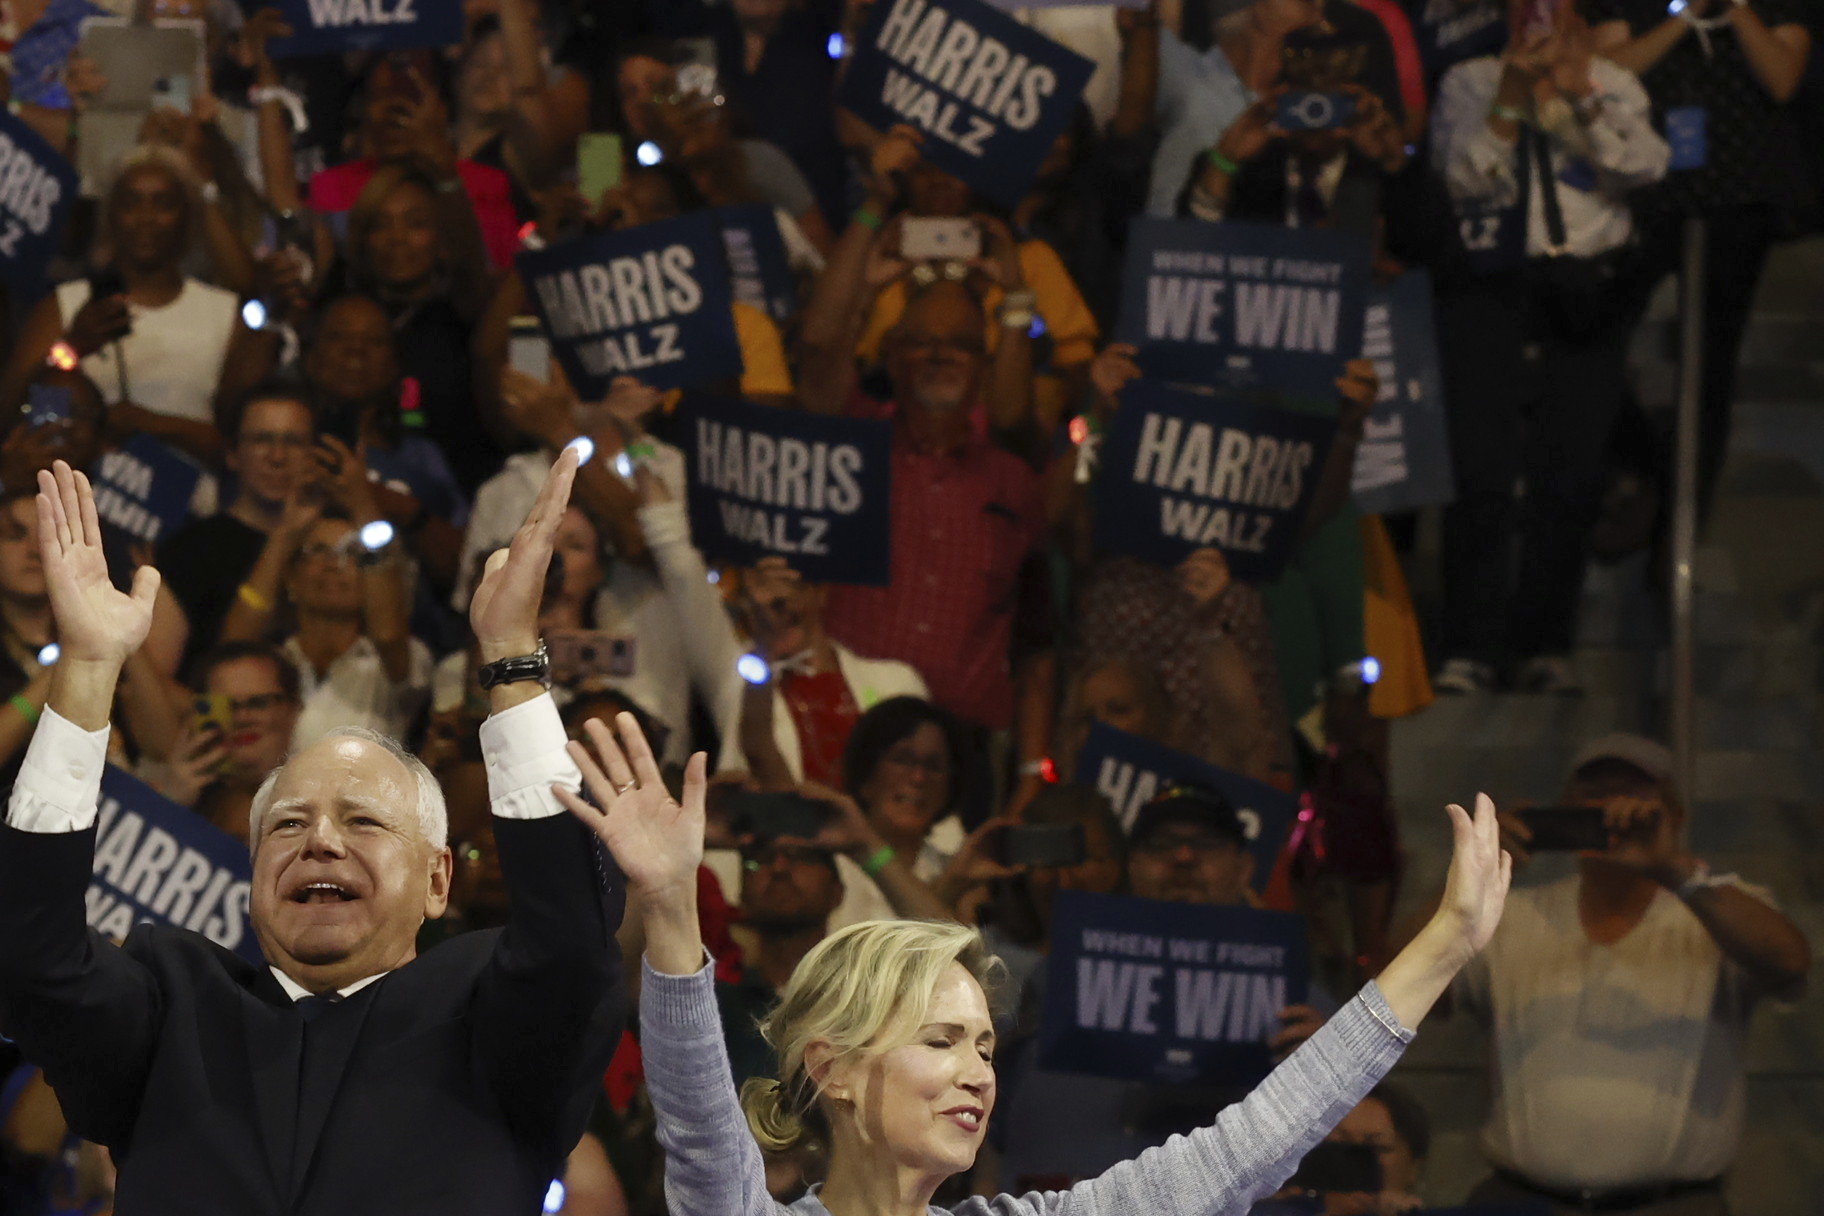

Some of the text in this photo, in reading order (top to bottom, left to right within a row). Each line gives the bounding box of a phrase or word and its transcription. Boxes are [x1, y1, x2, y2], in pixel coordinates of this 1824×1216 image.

[875, 0, 1057, 130] HARRIS
[881, 68, 996, 157] WALZ
[534, 243, 704, 339] HARRIS
[1152, 249, 1226, 274] WHEN
[1228, 253, 1269, 278] WE
[576, 323, 686, 377] WALZ
[1146, 276, 1341, 355] WE WIN
[696, 416, 864, 516] HARRIS
[1132, 410, 1315, 510] HARRIS
[718, 499, 832, 557] WALZ
[1159, 496, 1274, 553] WALZ
[84, 883, 136, 946] WA
[1081, 928, 1288, 969] WHEN WE FIGHT
[1077, 957, 1288, 1044] WE WIN
